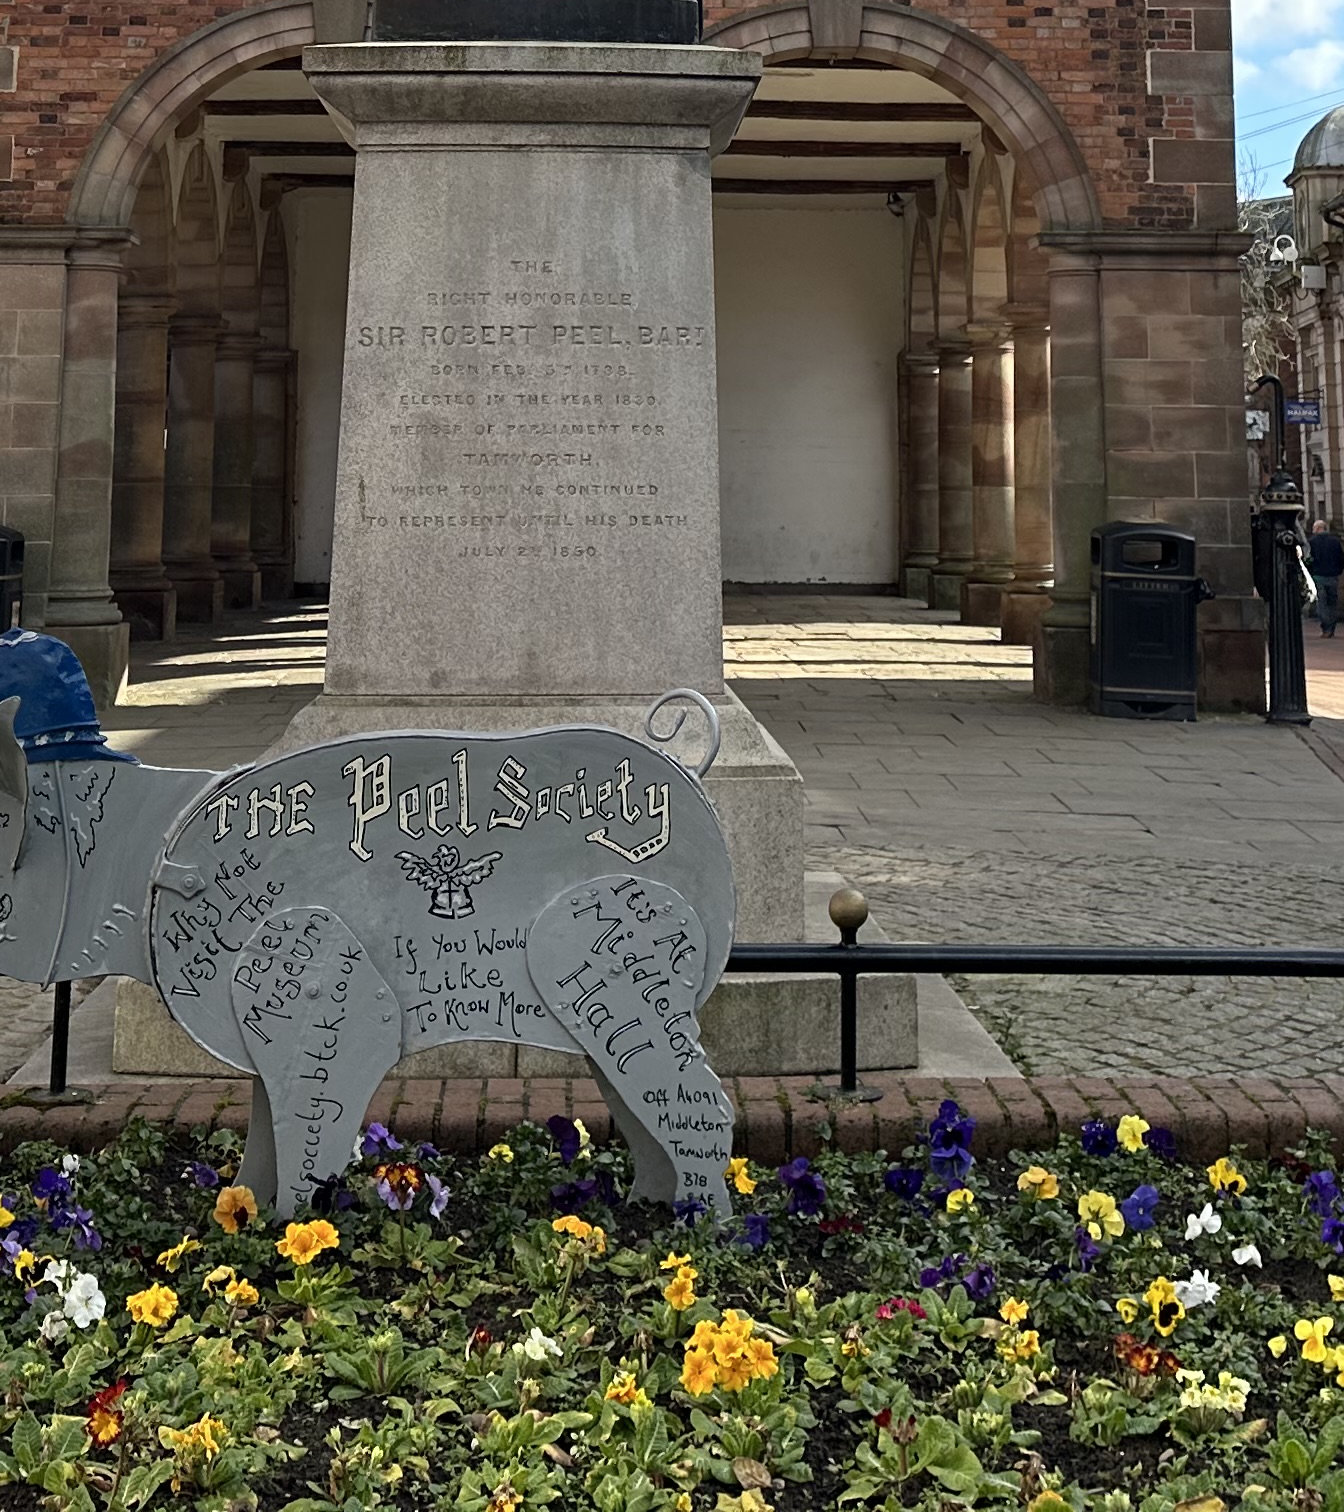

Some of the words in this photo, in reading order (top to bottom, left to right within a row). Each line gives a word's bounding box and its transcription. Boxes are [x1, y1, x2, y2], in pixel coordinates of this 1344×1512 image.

[509, 260, 554, 273] THE
[427, 292, 492, 306] RIGHT
[357, 325, 407, 348] SIR
[420, 325, 539, 347] ROBERT
[431, 364, 479, 376] BORN
[400, 394, 476, 406] ELECTED
[487, 394, 505, 406] IN
[515, 394, 551, 406] THE
[561, 394, 603, 406] YEAR
[475, 424, 494, 436] OF
[507, 423, 621, 436] PARLIAMENT
[632, 424, 666, 437] FOR
[556, 484, 659, 497] CONTINUED
[366, 515, 389, 528] TO
[399, 515, 507, 528] REPRESENT
[519, 515, 574, 528] UNTIL
[585, 515, 618, 528] HIS
[629, 515, 689, 527] DEATH
[458, 546, 505, 557] JULY
[206, 779, 315, 844] THE
[341, 749, 479, 862] Peel
[487, 754, 672, 865] Society
[163, 896, 223, 952] Why
[214, 847, 262, 901] Not
[610, 878, 657, 923] It's
[653, 930, 697, 975] At
[171, 929, 243, 998] Visit
[228, 880, 286, 923] The
[234, 918, 297, 994] Peel
[393, 935, 418, 975] If
[432, 934, 467, 960] You
[473, 927, 528, 955] Would
[242, 912, 330, 1045] Museum
[419, 962, 504, 994] Like
[573, 901, 696, 1072] Middleton
[406, 1000, 437, 1033] To
[444, 998, 490, 1031] Know
[495, 991, 546, 1038] More
[556, 960, 655, 1075] Hall
[290, 945, 363, 1206] elsociety.btck.co.uk
[677, 1083, 719, 1106] A4091
[658, 1112, 724, 1133] Middleton
[669, 1140, 728, 1162] Tamworth
[682, 1172, 707, 1187] B78
